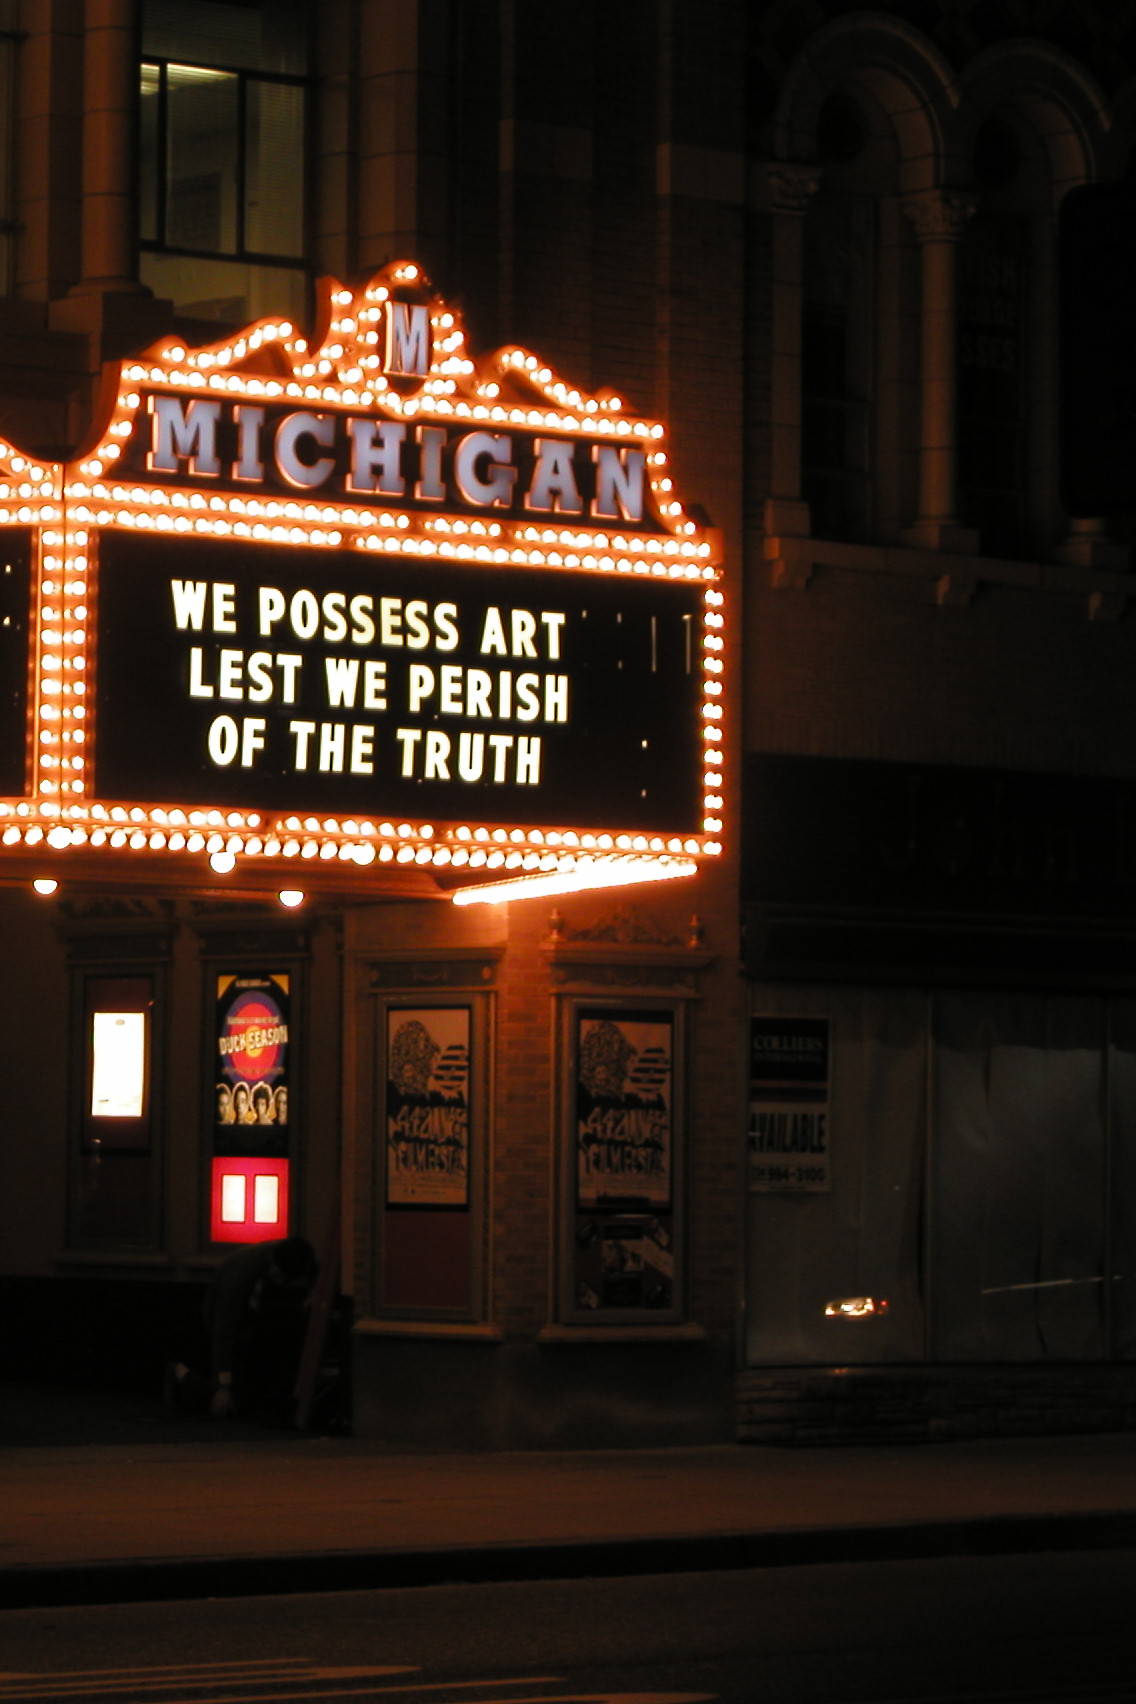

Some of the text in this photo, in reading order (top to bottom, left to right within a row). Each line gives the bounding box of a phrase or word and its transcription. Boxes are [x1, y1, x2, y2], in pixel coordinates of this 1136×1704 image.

[385, 300, 429, 377] M
[147, 395, 645, 521] MICHIGAN
[171, 579, 566, 660] WE POSSESS ART
[189, 647, 568, 723] LEST WE PERISH
[208, 714, 541, 785] OF THE TRUTH
[219, 1025, 288, 1055] DUCK SEASON
[753, 1035, 823, 1051] COLLIERS
[749, 1113, 825, 1153] AVAILABLE
